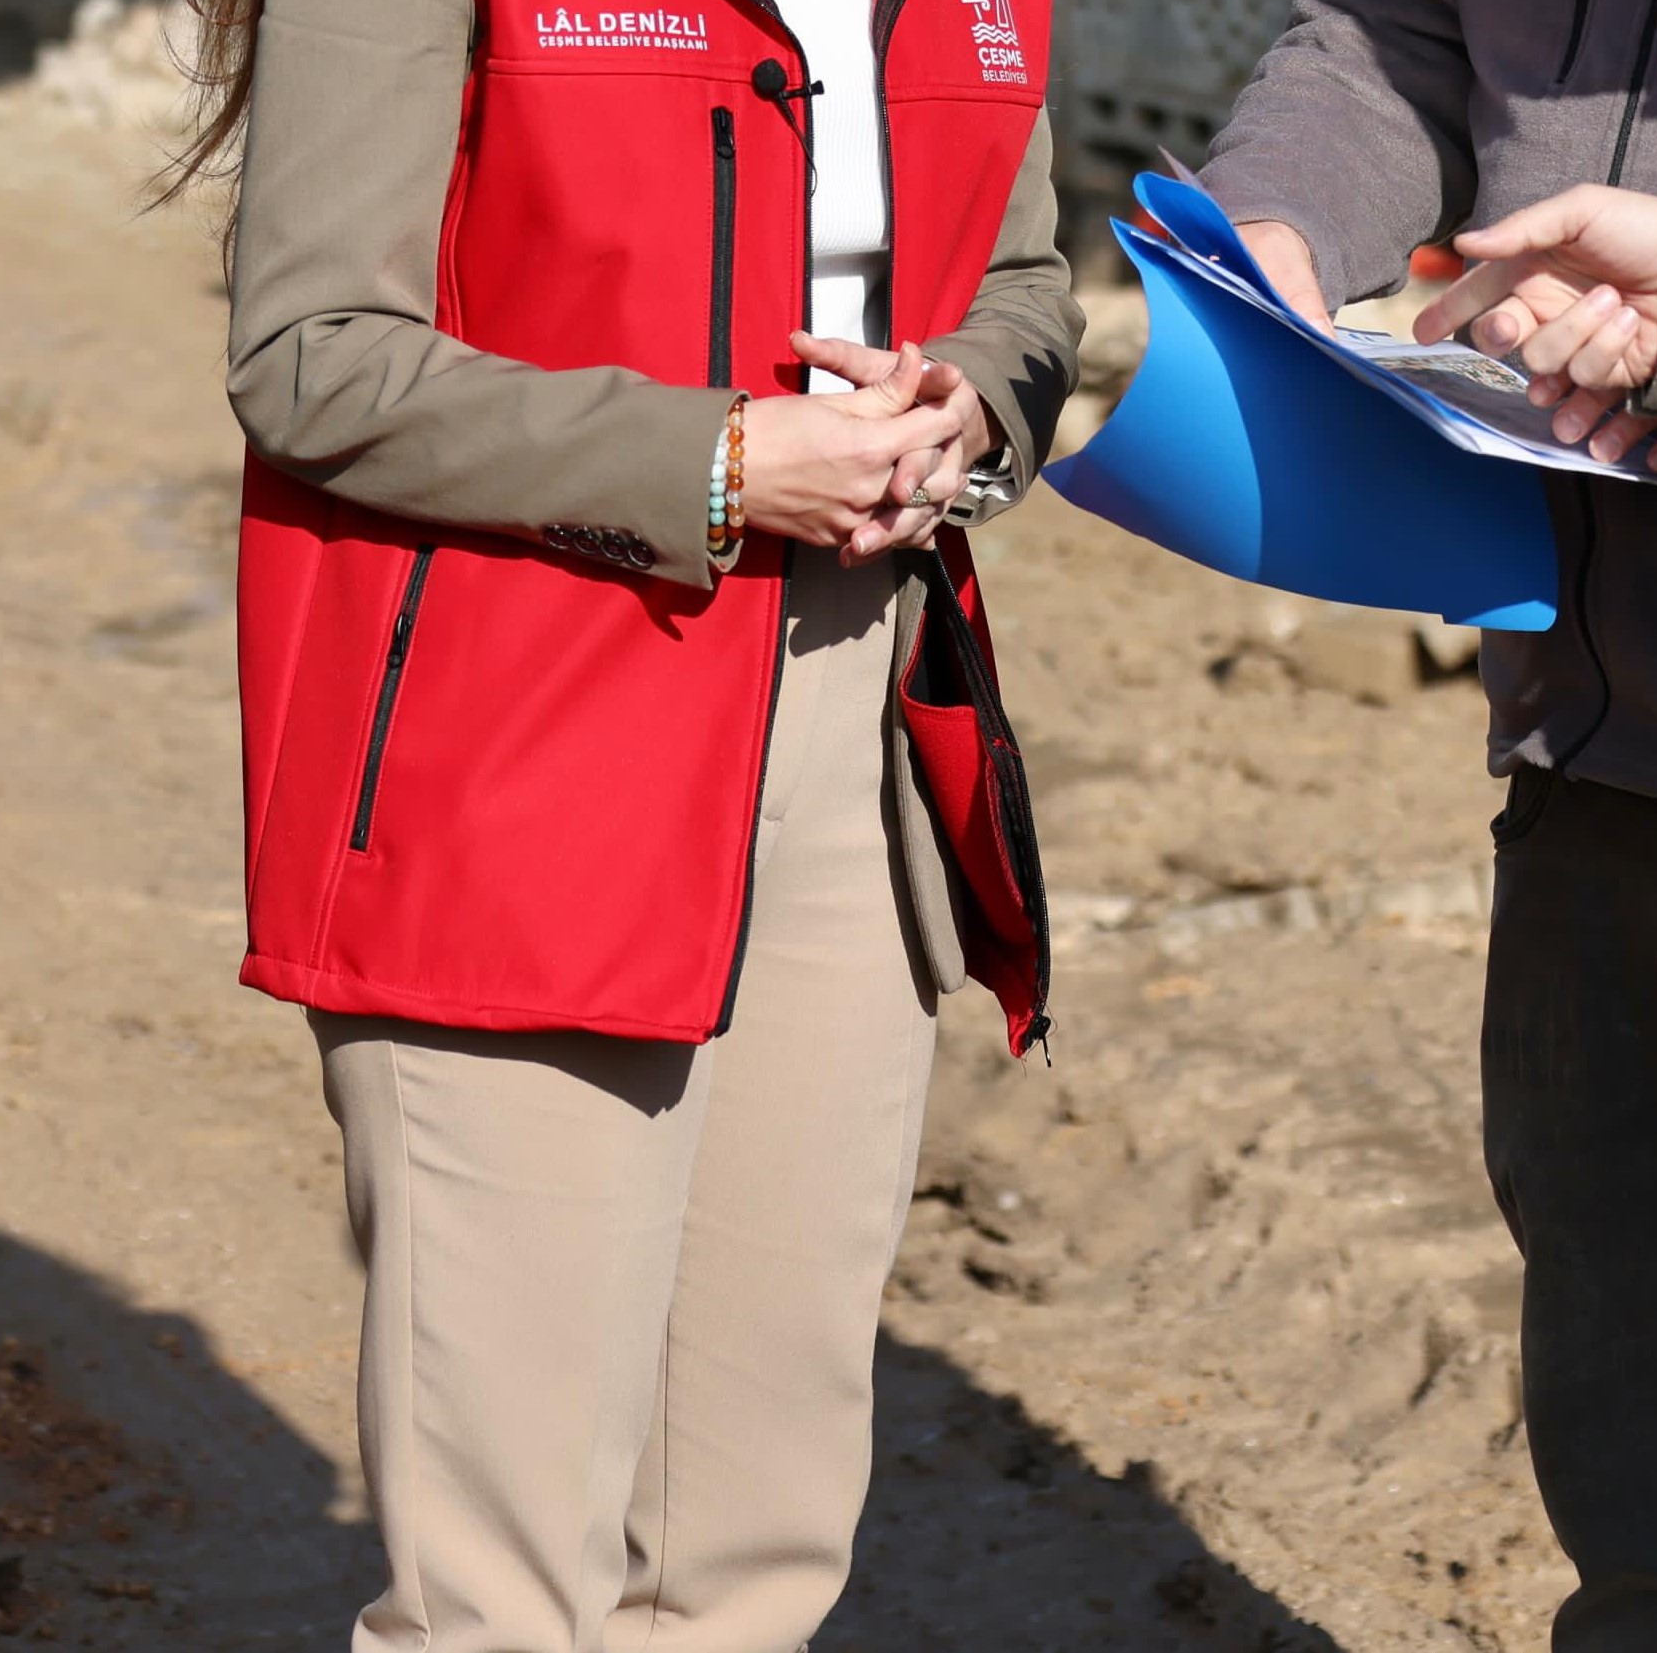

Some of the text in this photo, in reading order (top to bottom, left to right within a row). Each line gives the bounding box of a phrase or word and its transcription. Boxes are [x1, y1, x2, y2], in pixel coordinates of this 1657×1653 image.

[536, 7, 706, 38] LÂL DENİZLİ
[538, 33, 709, 51] ÇEŞME BELEDİYE BAŞKANI
[978, 46, 1025, 69] ÇEŞME
[982, 68, 1028, 85] BELEDİYESİ
